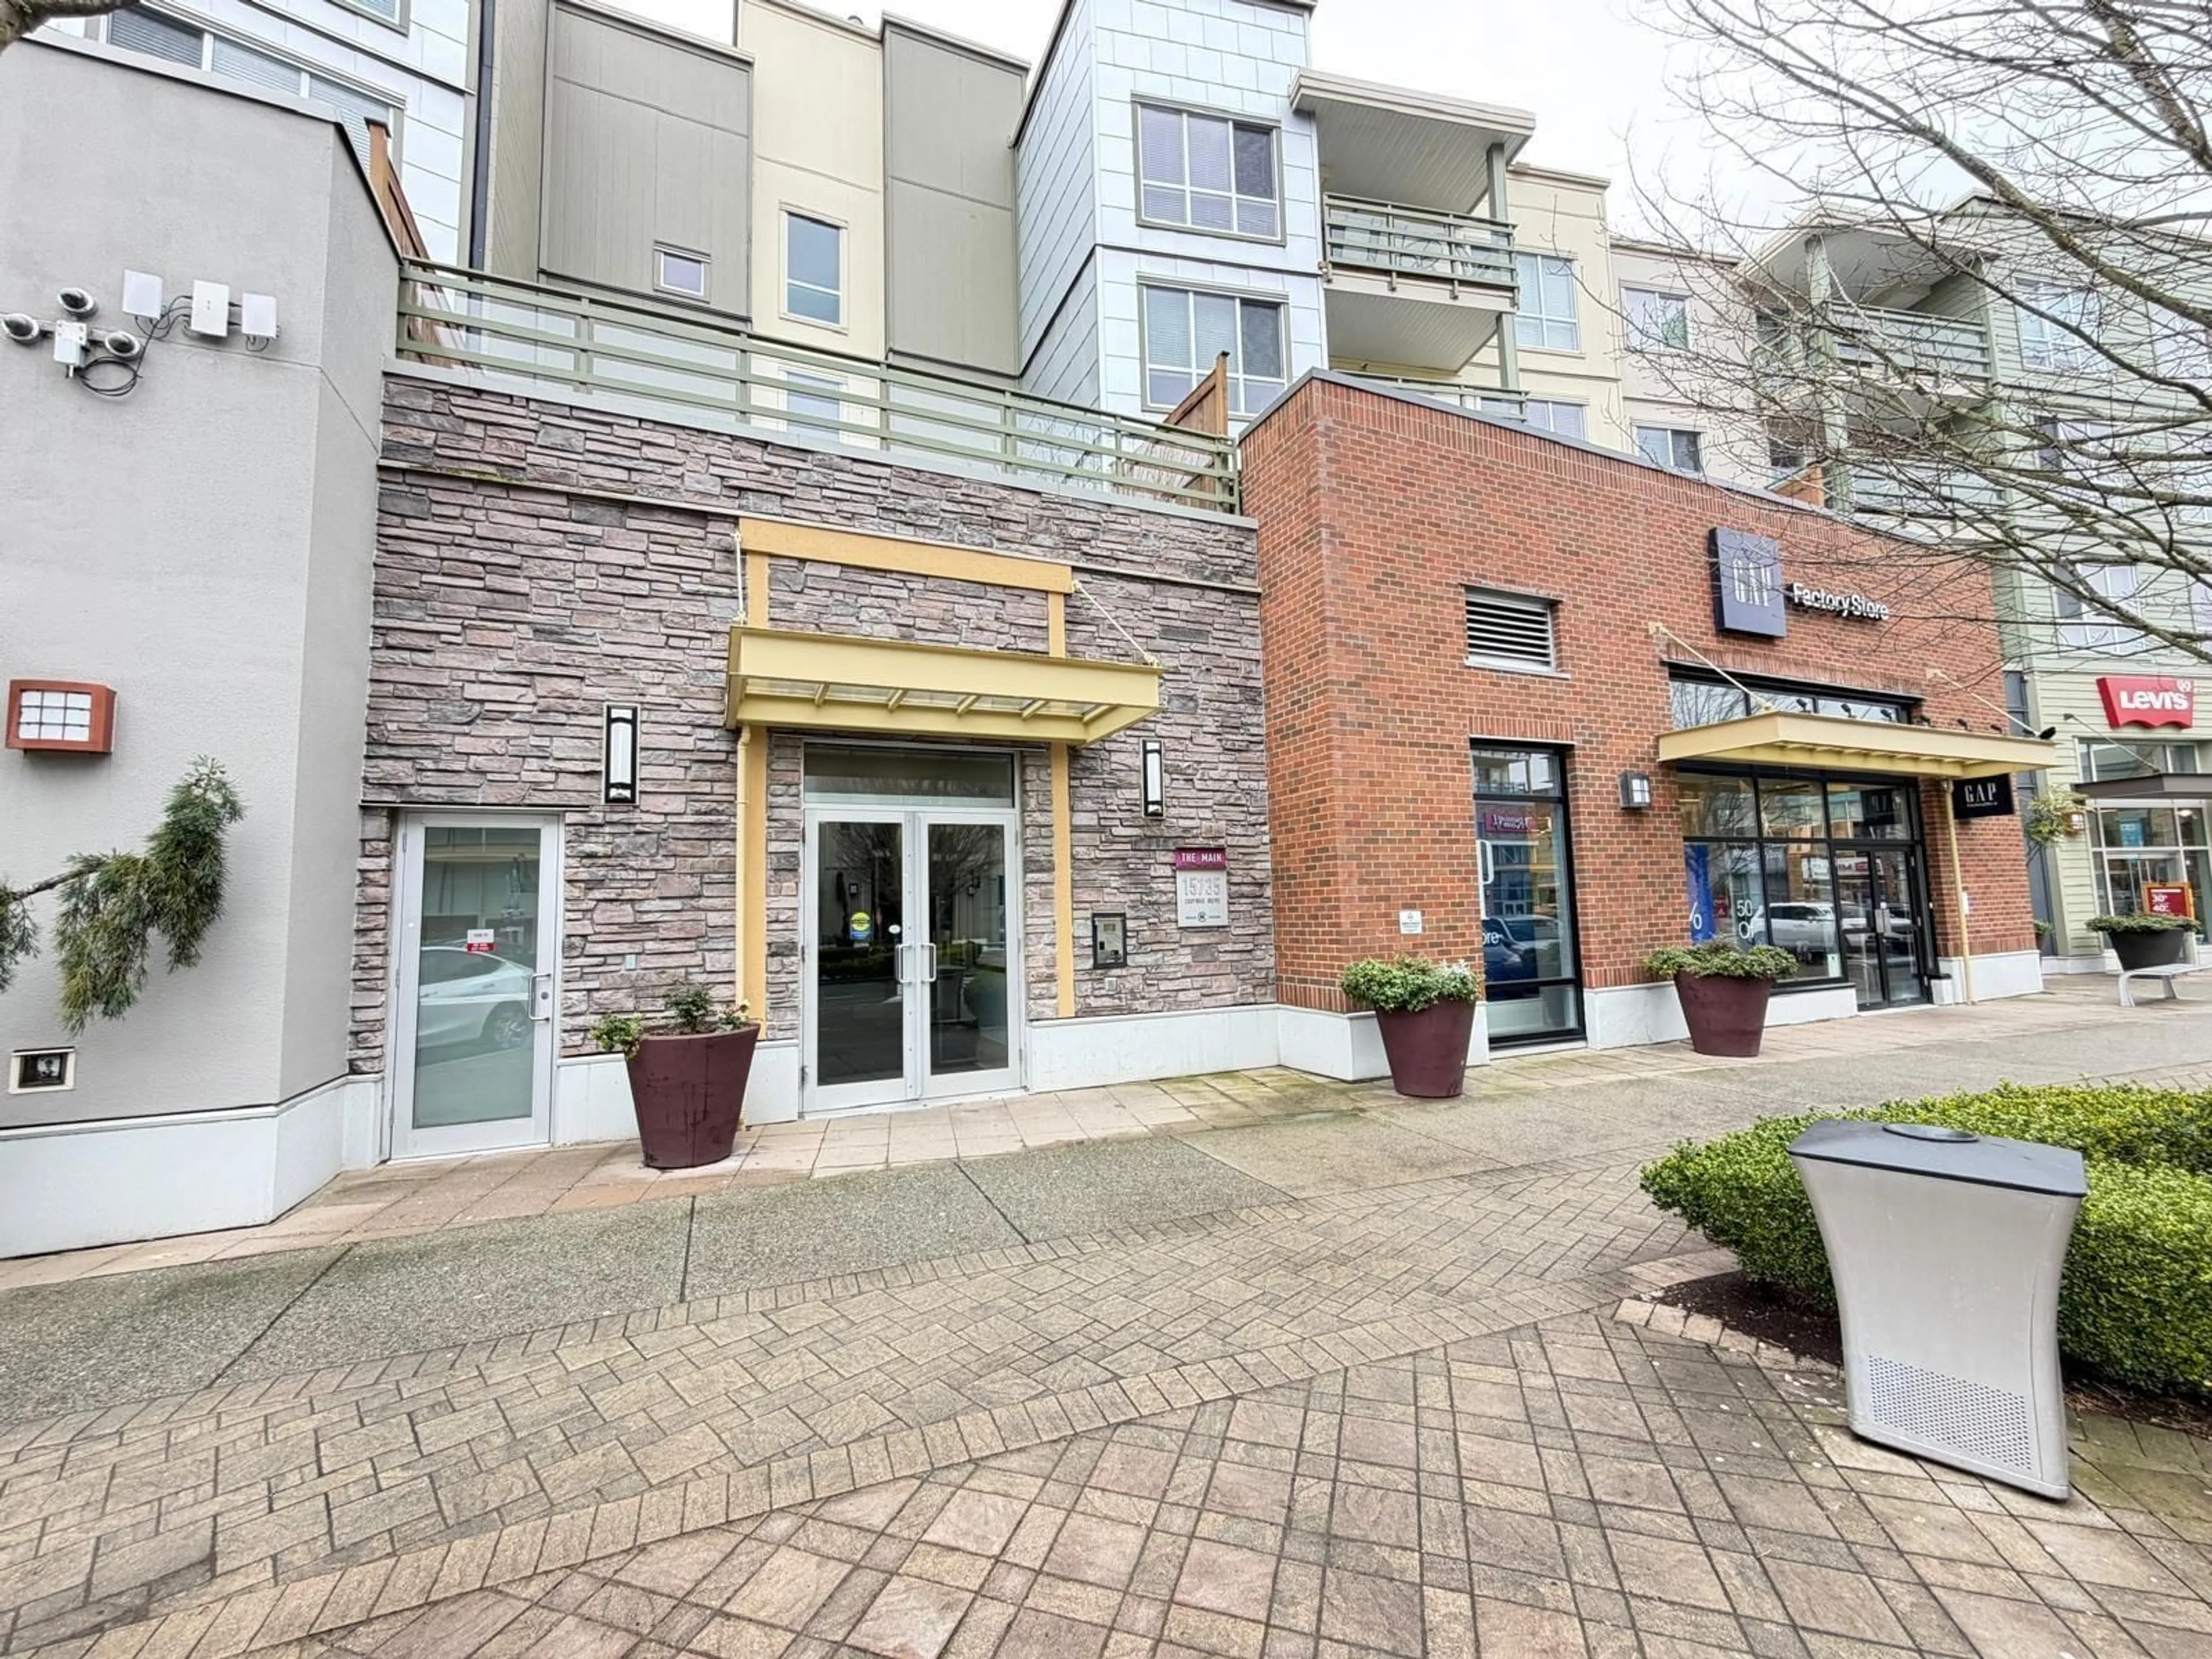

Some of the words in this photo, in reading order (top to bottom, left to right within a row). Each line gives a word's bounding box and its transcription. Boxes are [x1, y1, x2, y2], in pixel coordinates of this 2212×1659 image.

[1793, 582, 1850, 617] Factory
[1851, 594, 1890, 620] Store
[1964, 782, 1997, 802] GAP
[1181, 853, 1196, 862] THE
[1201, 853, 1222, 862] MAIN
